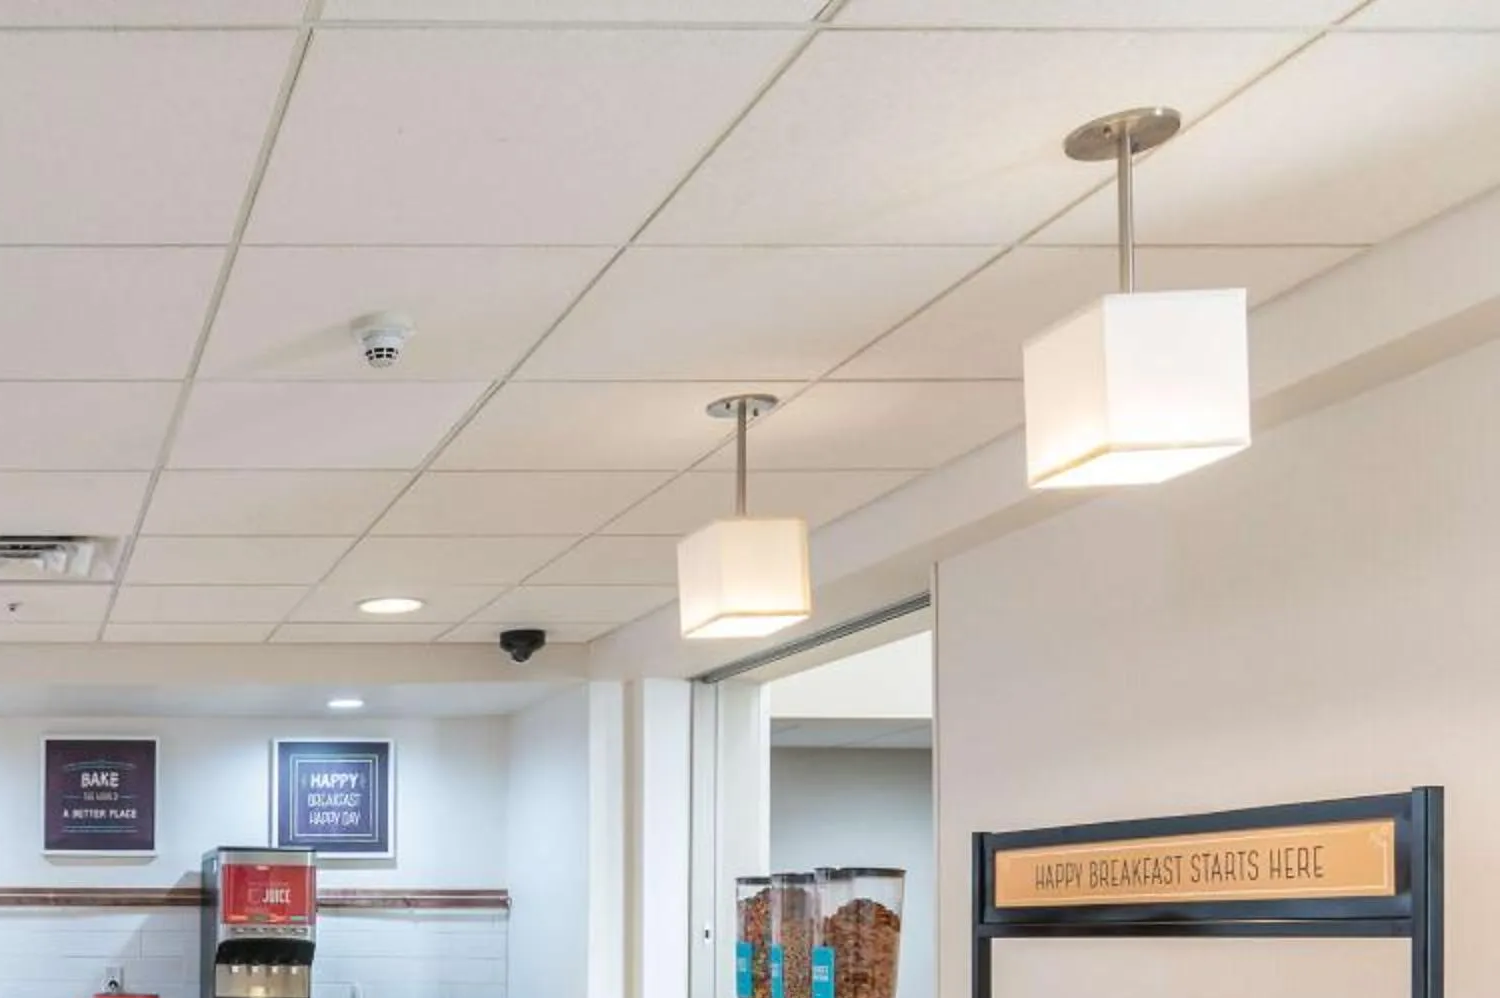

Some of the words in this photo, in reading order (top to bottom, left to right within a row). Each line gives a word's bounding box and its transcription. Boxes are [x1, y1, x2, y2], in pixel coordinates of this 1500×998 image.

[81, 770, 120, 788] BAKE
[309, 772, 359, 789] HAPPY
[307, 793, 362, 808] BREAKFAST
[62, 807, 70, 819] A
[72, 808, 107, 819] BETTER
[109, 808, 138, 819] PLACE
[309, 810, 342, 825] HAPPY
[342, 809, 361, 826] DAY
[1034, 861, 1083, 890] HAPPY
[1089, 855, 1184, 889] BREAKFAST
[1190, 849, 1260, 884] STARTS
[1269, 844, 1326, 880] HERE
[261, 887, 292, 904] JUICE
